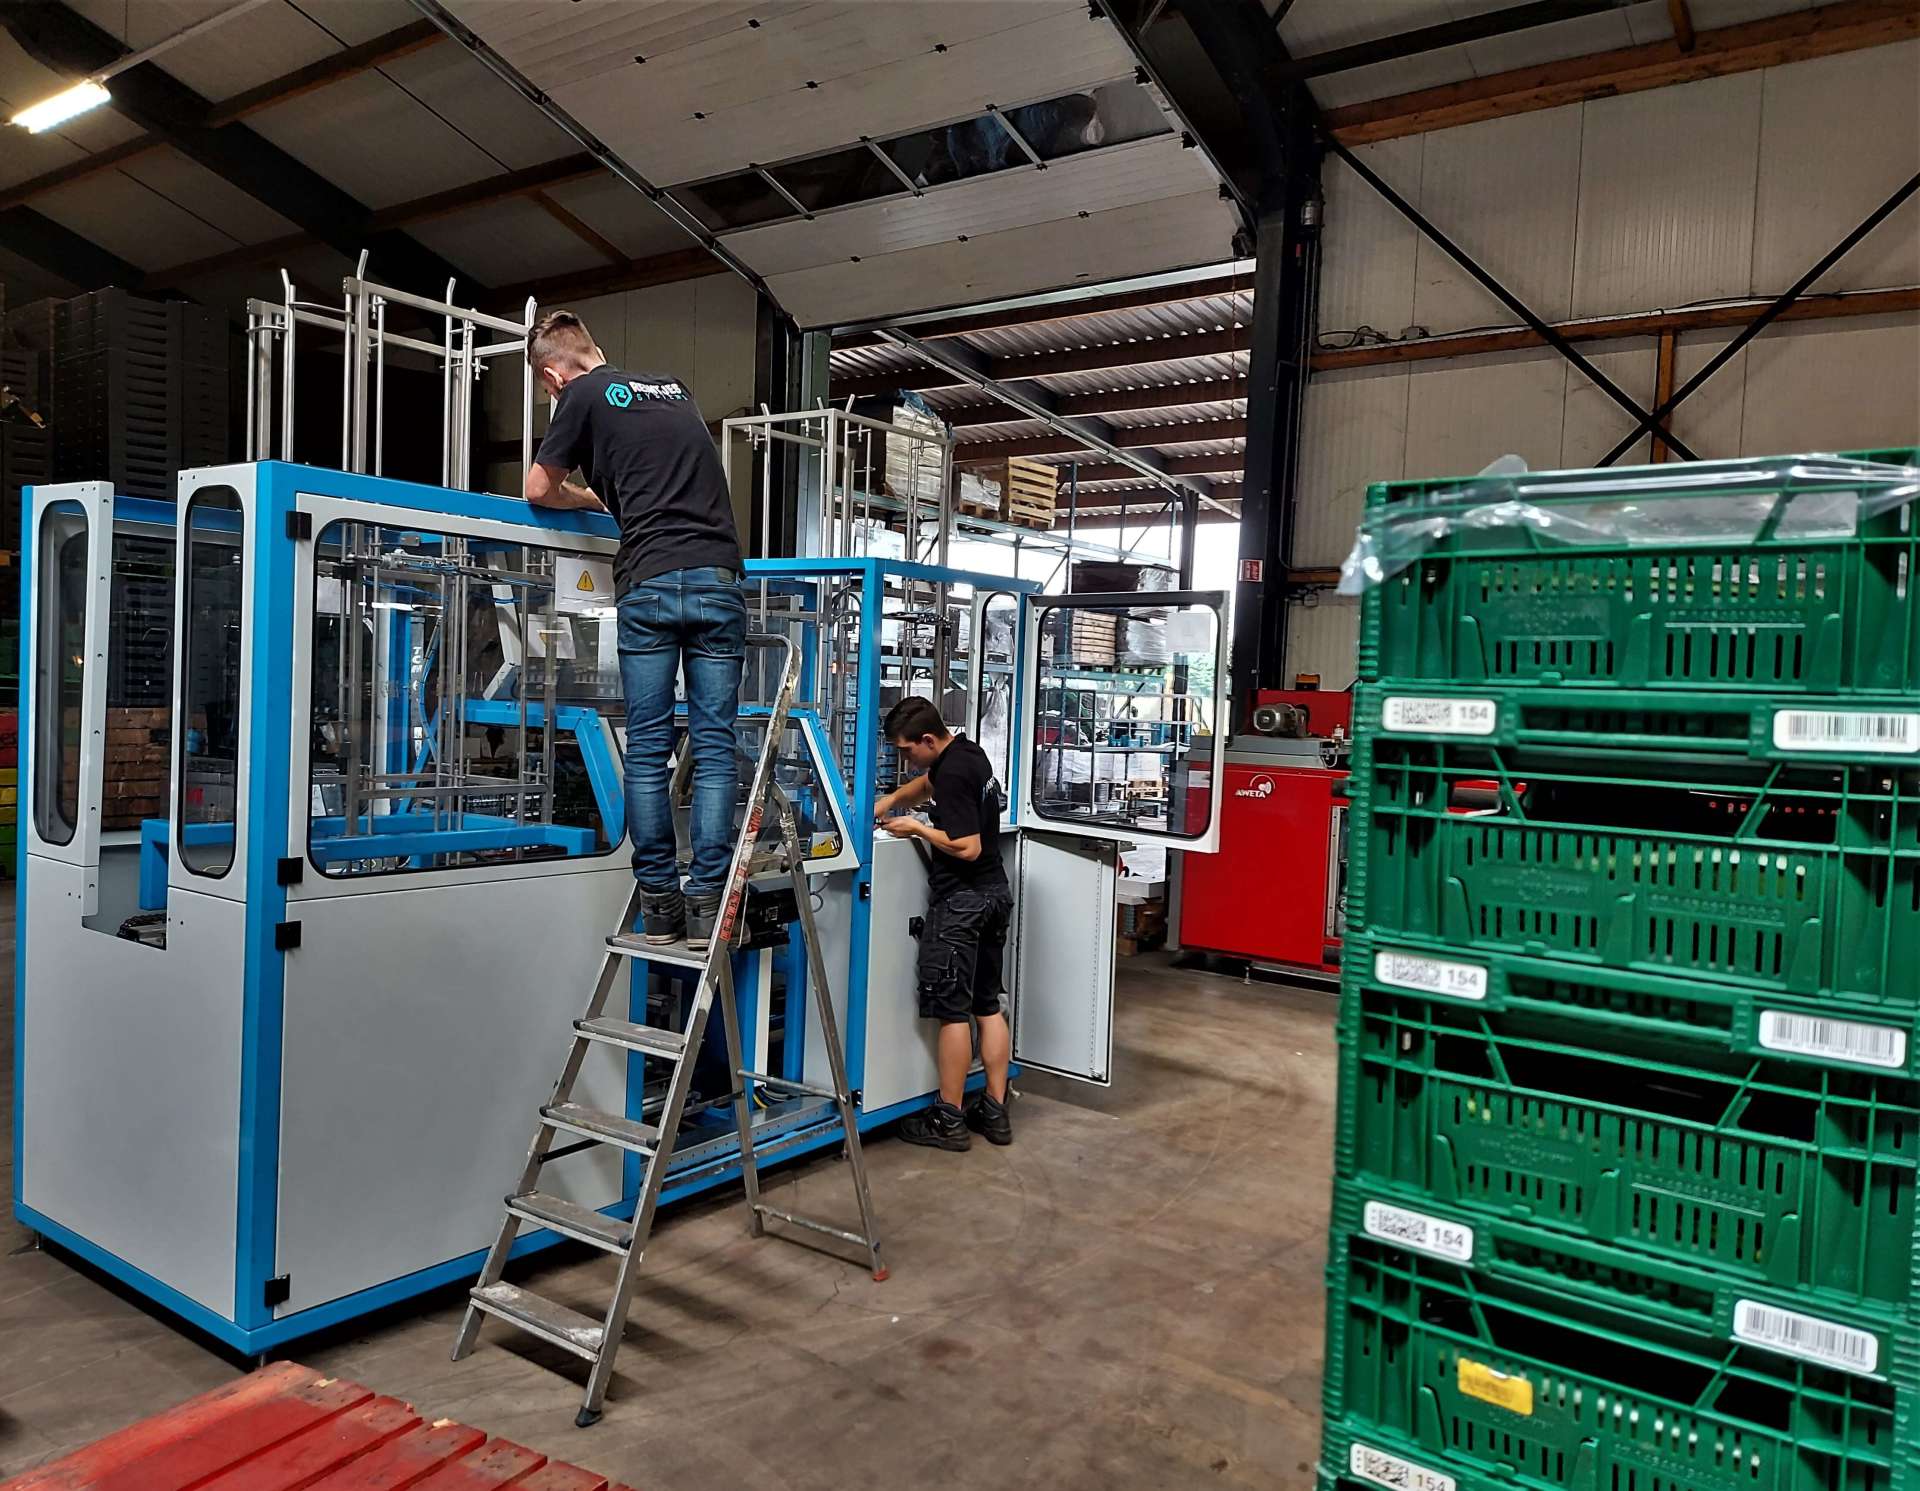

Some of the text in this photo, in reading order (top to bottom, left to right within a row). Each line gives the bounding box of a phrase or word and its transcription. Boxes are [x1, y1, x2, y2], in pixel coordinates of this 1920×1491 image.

[1459, 705, 1489, 720] 154
[1234, 788, 1266, 799] AWETA
[1447, 968, 1478, 986] 154
[1434, 1227, 1464, 1248] 154
